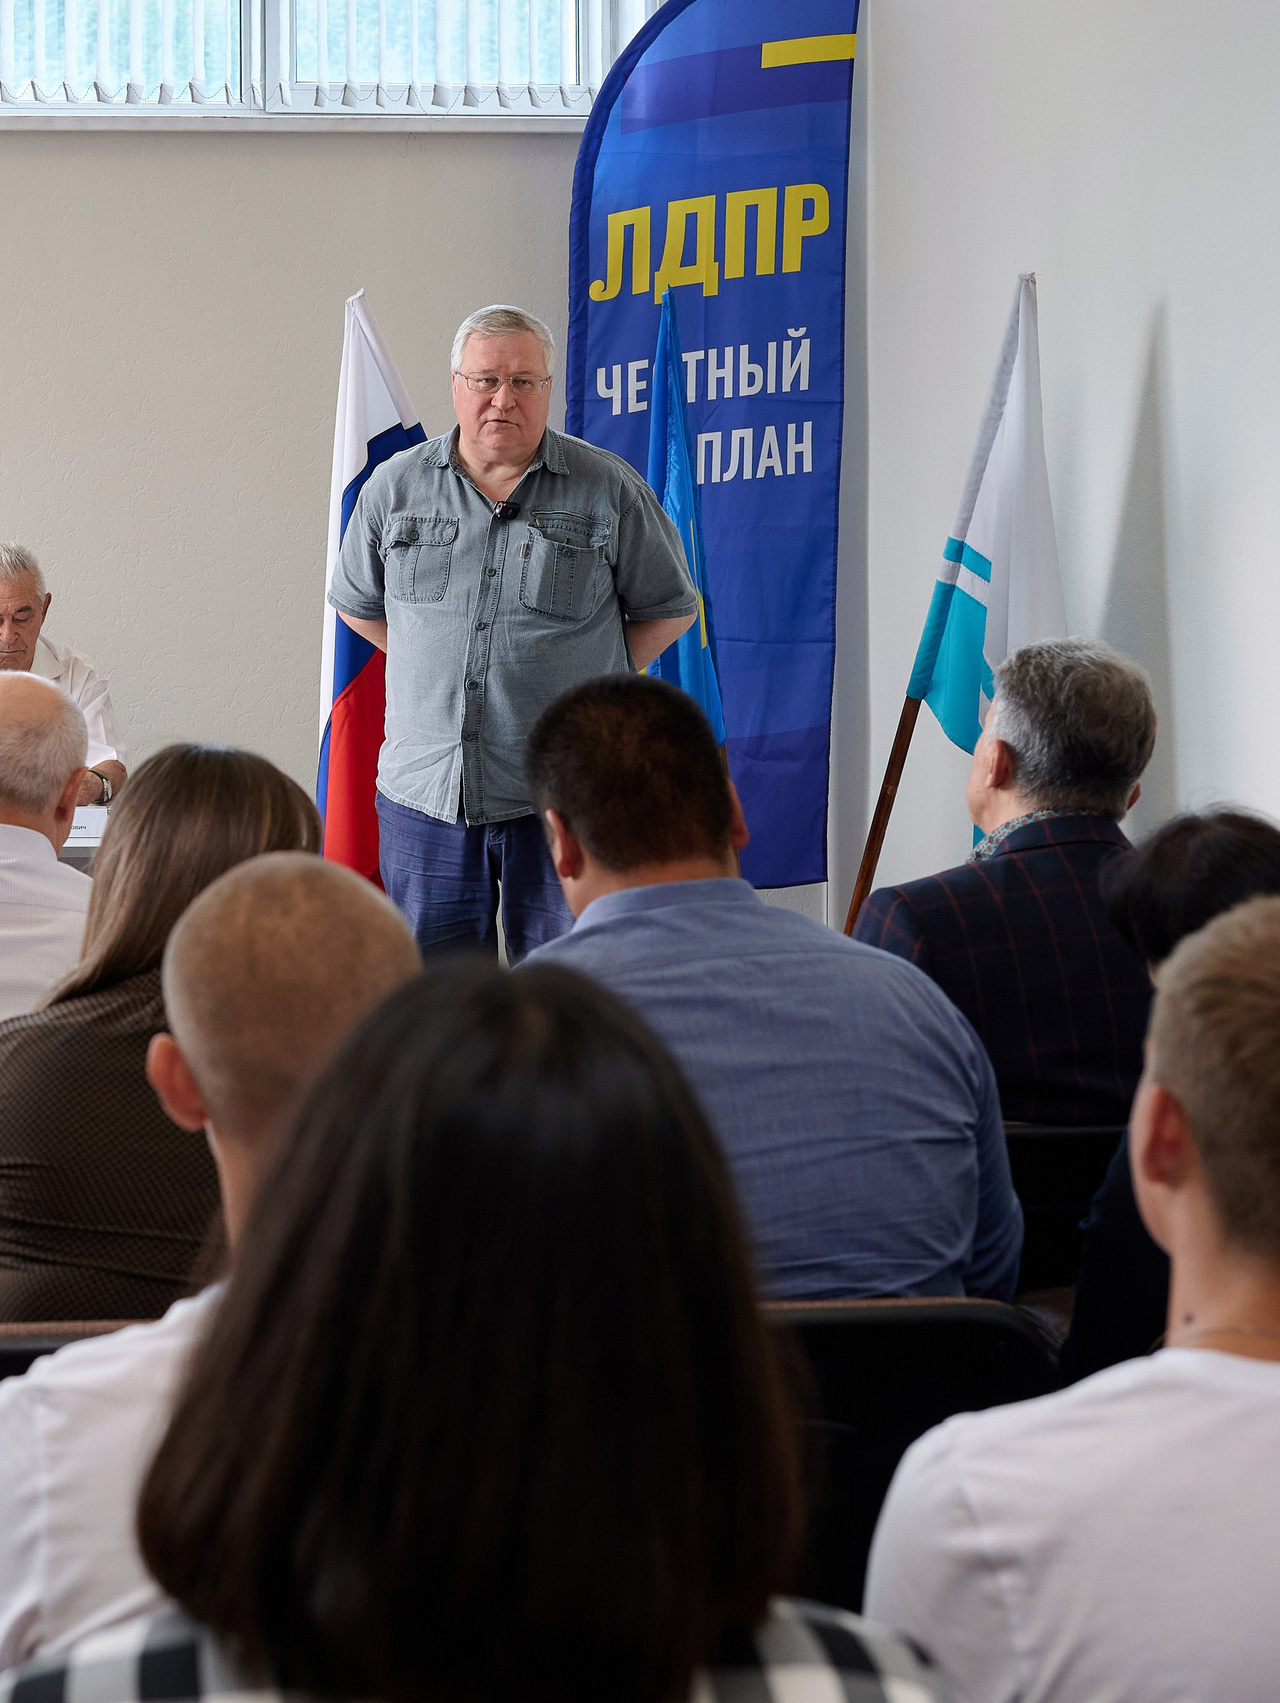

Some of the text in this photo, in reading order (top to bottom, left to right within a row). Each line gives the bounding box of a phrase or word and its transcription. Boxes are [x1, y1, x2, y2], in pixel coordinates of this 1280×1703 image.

[588, 183, 830, 305] ЛДПР
[595, 327, 811, 416] ЧЕТНЫЙ
[696, 420, 814, 485] ПЛАН
